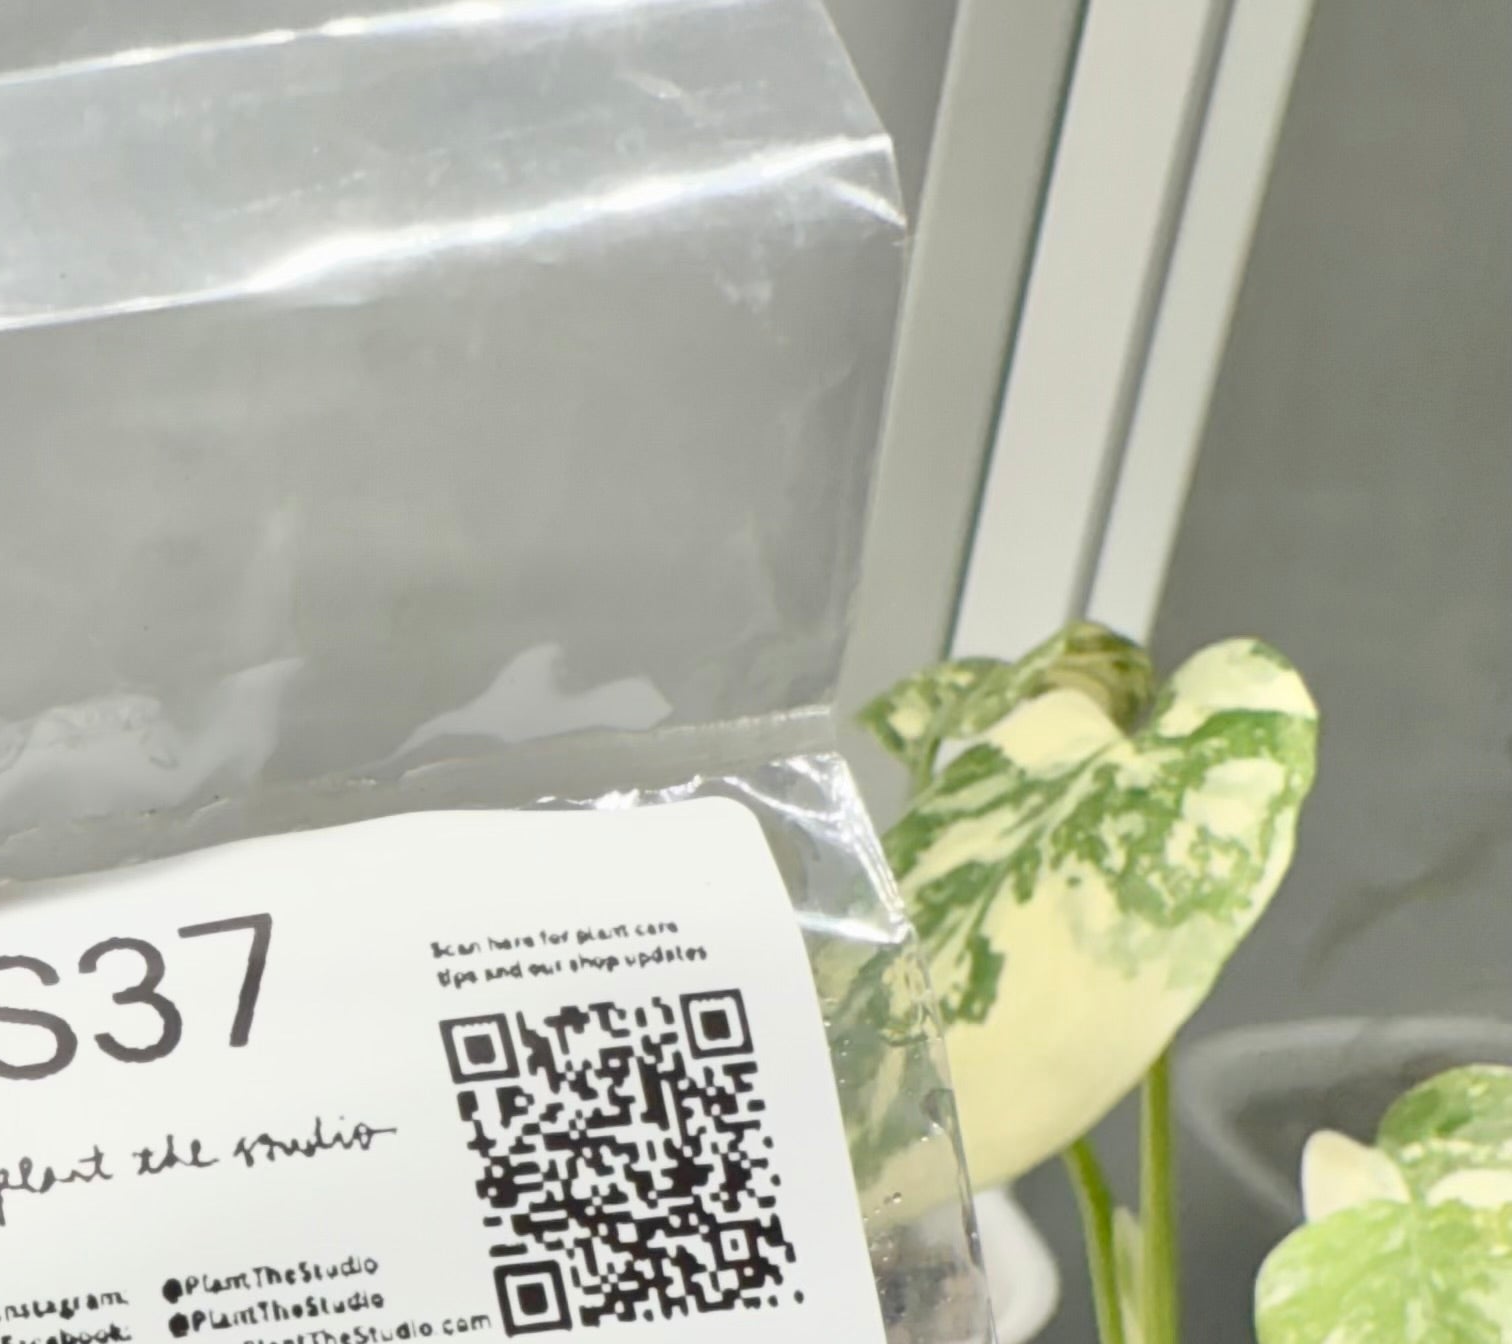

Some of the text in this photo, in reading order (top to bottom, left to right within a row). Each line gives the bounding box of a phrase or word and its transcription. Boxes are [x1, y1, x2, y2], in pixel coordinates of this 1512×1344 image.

[484, 961, 524, 982] and
[624, 944, 708, 969] updates
[132, 1133, 221, 1176] the
[232, 1114, 398, 1168] studio
